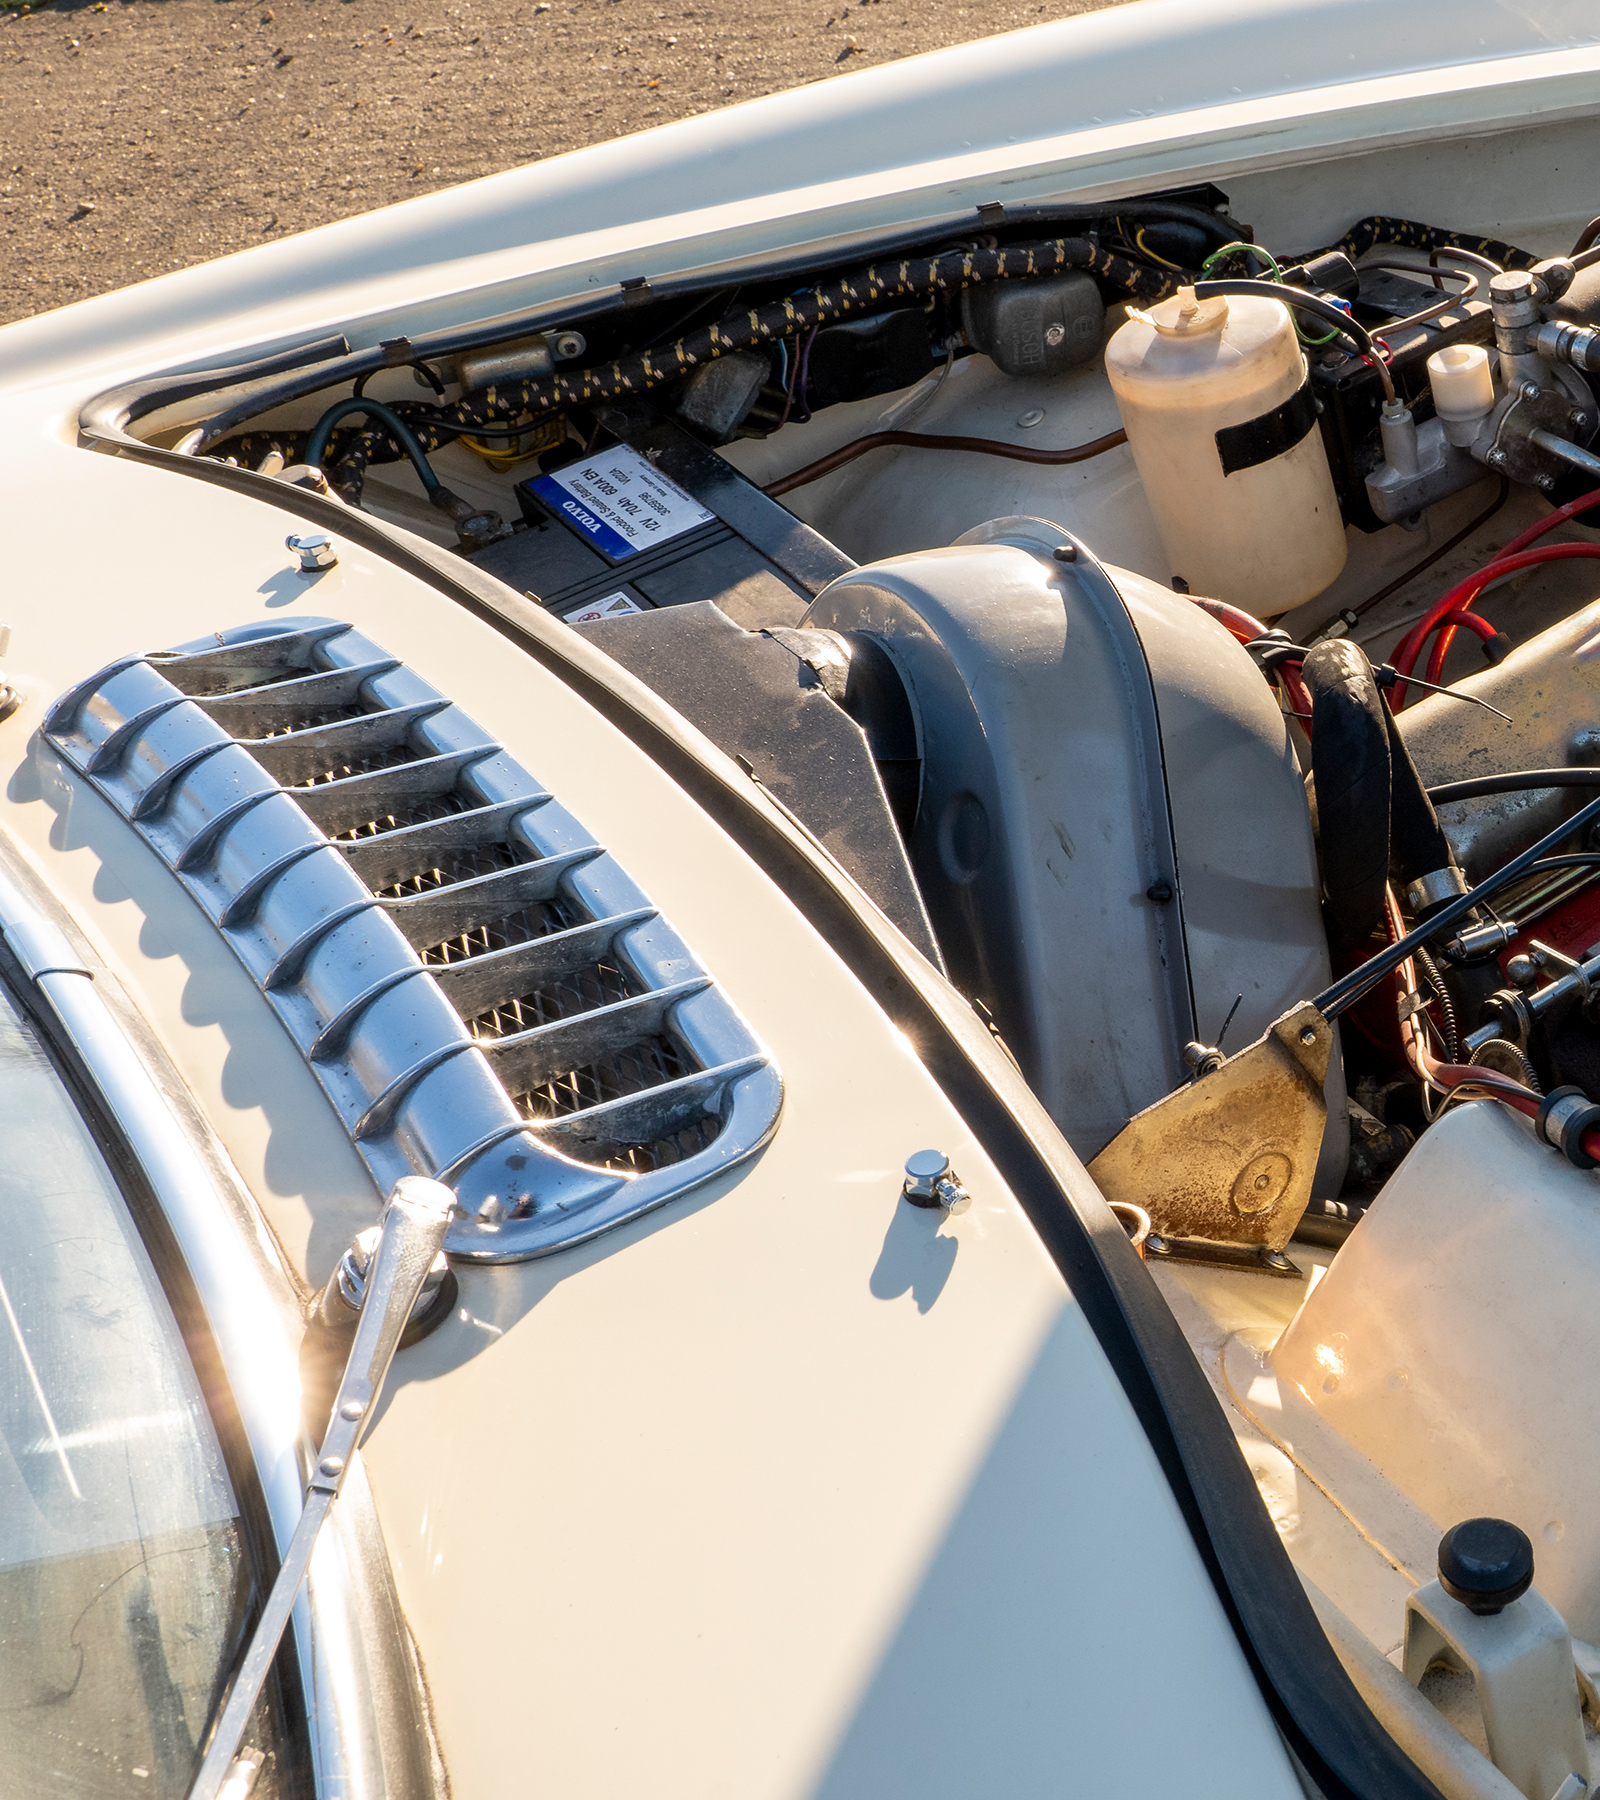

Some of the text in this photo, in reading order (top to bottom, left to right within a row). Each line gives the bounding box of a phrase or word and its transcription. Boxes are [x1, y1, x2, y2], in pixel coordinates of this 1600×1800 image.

[1020, 309, 1043, 365] BOSCH
[568, 479, 592, 499] Battery
[639, 474, 655, 487] Germany
[580, 468, 661, 531] 12V 70Ah 600A EN
[656, 488, 667, 497] Made
[586, 496, 611, 514] Sealed
[638, 492, 671, 516] 30659798
[562, 501, 601, 533] VOLVO
[611, 516, 639, 537] Flooded
